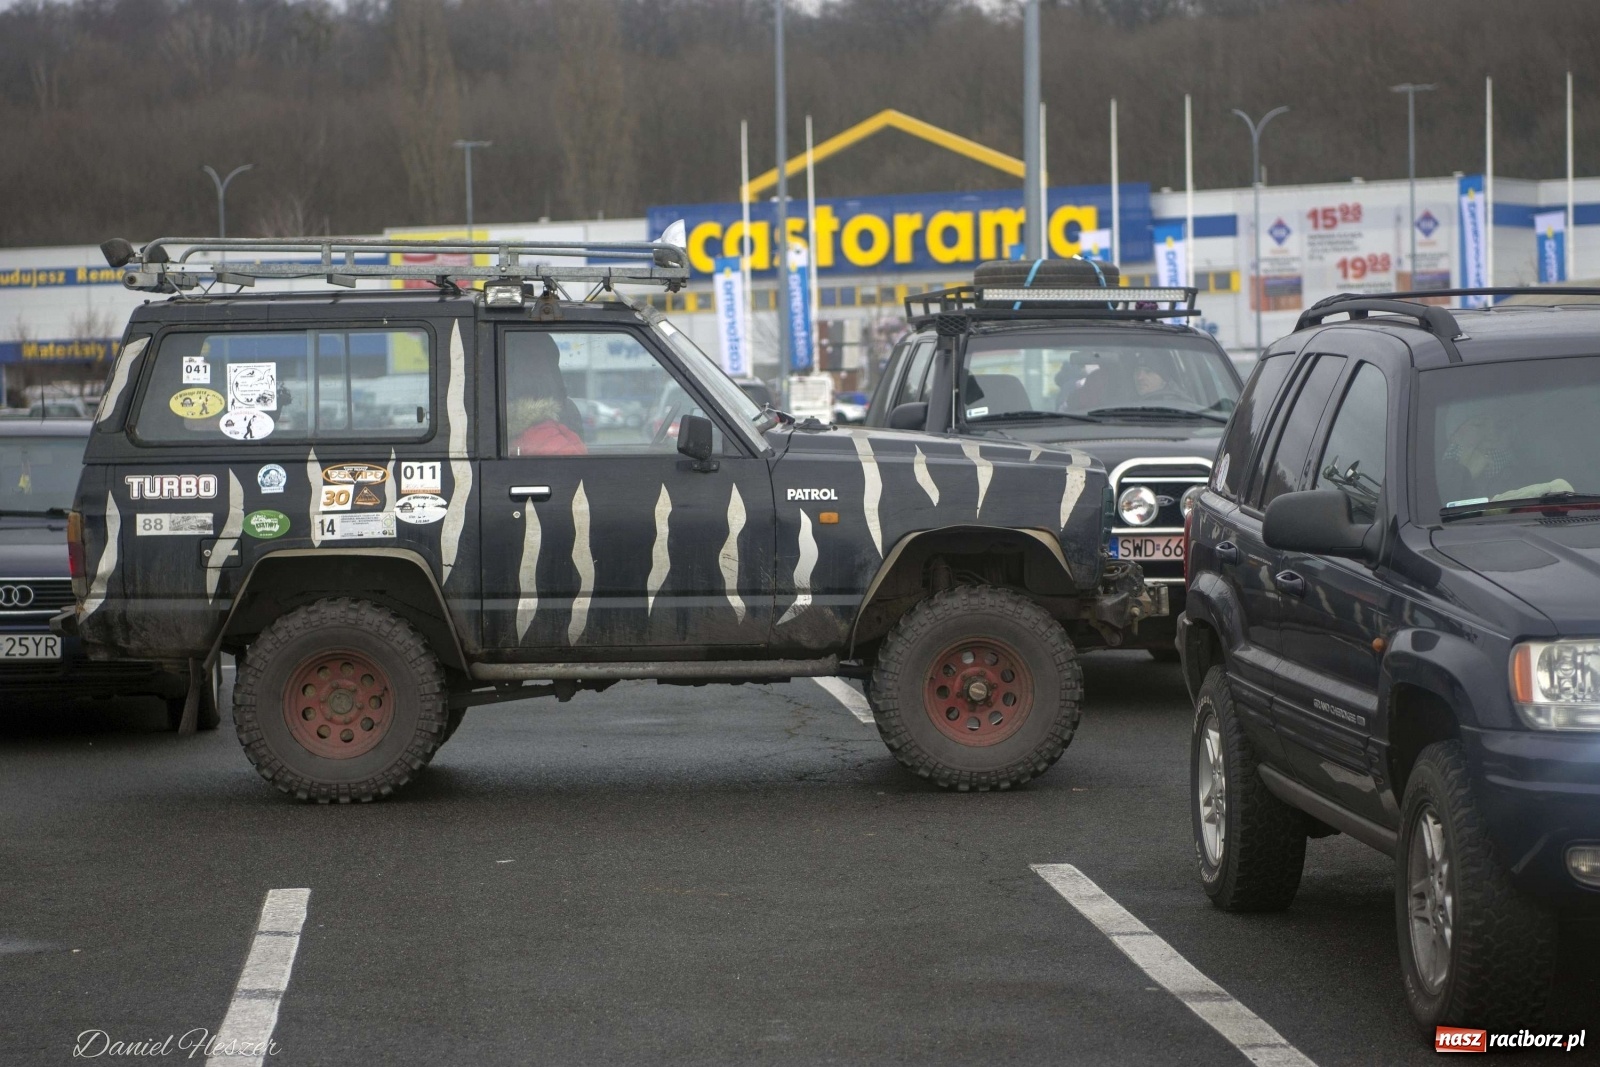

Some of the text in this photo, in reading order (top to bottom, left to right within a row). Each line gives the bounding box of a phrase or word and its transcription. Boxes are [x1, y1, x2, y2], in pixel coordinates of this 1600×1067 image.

[687, 204, 1098, 274] castorama
[185, 364, 208, 374] 041
[329, 470, 383, 479] ESCAPE
[403, 465, 436, 480] 011
[125, 474, 217, 499] TURBO
[787, 488, 838, 500] PATROL
[323, 489, 350, 507] 30
[142, 518, 163, 531] 88
[318, 518, 336, 536] 14
[1120, 538, 1184, 557] SWD 66
[5, 637, 57, 657] 25YR
